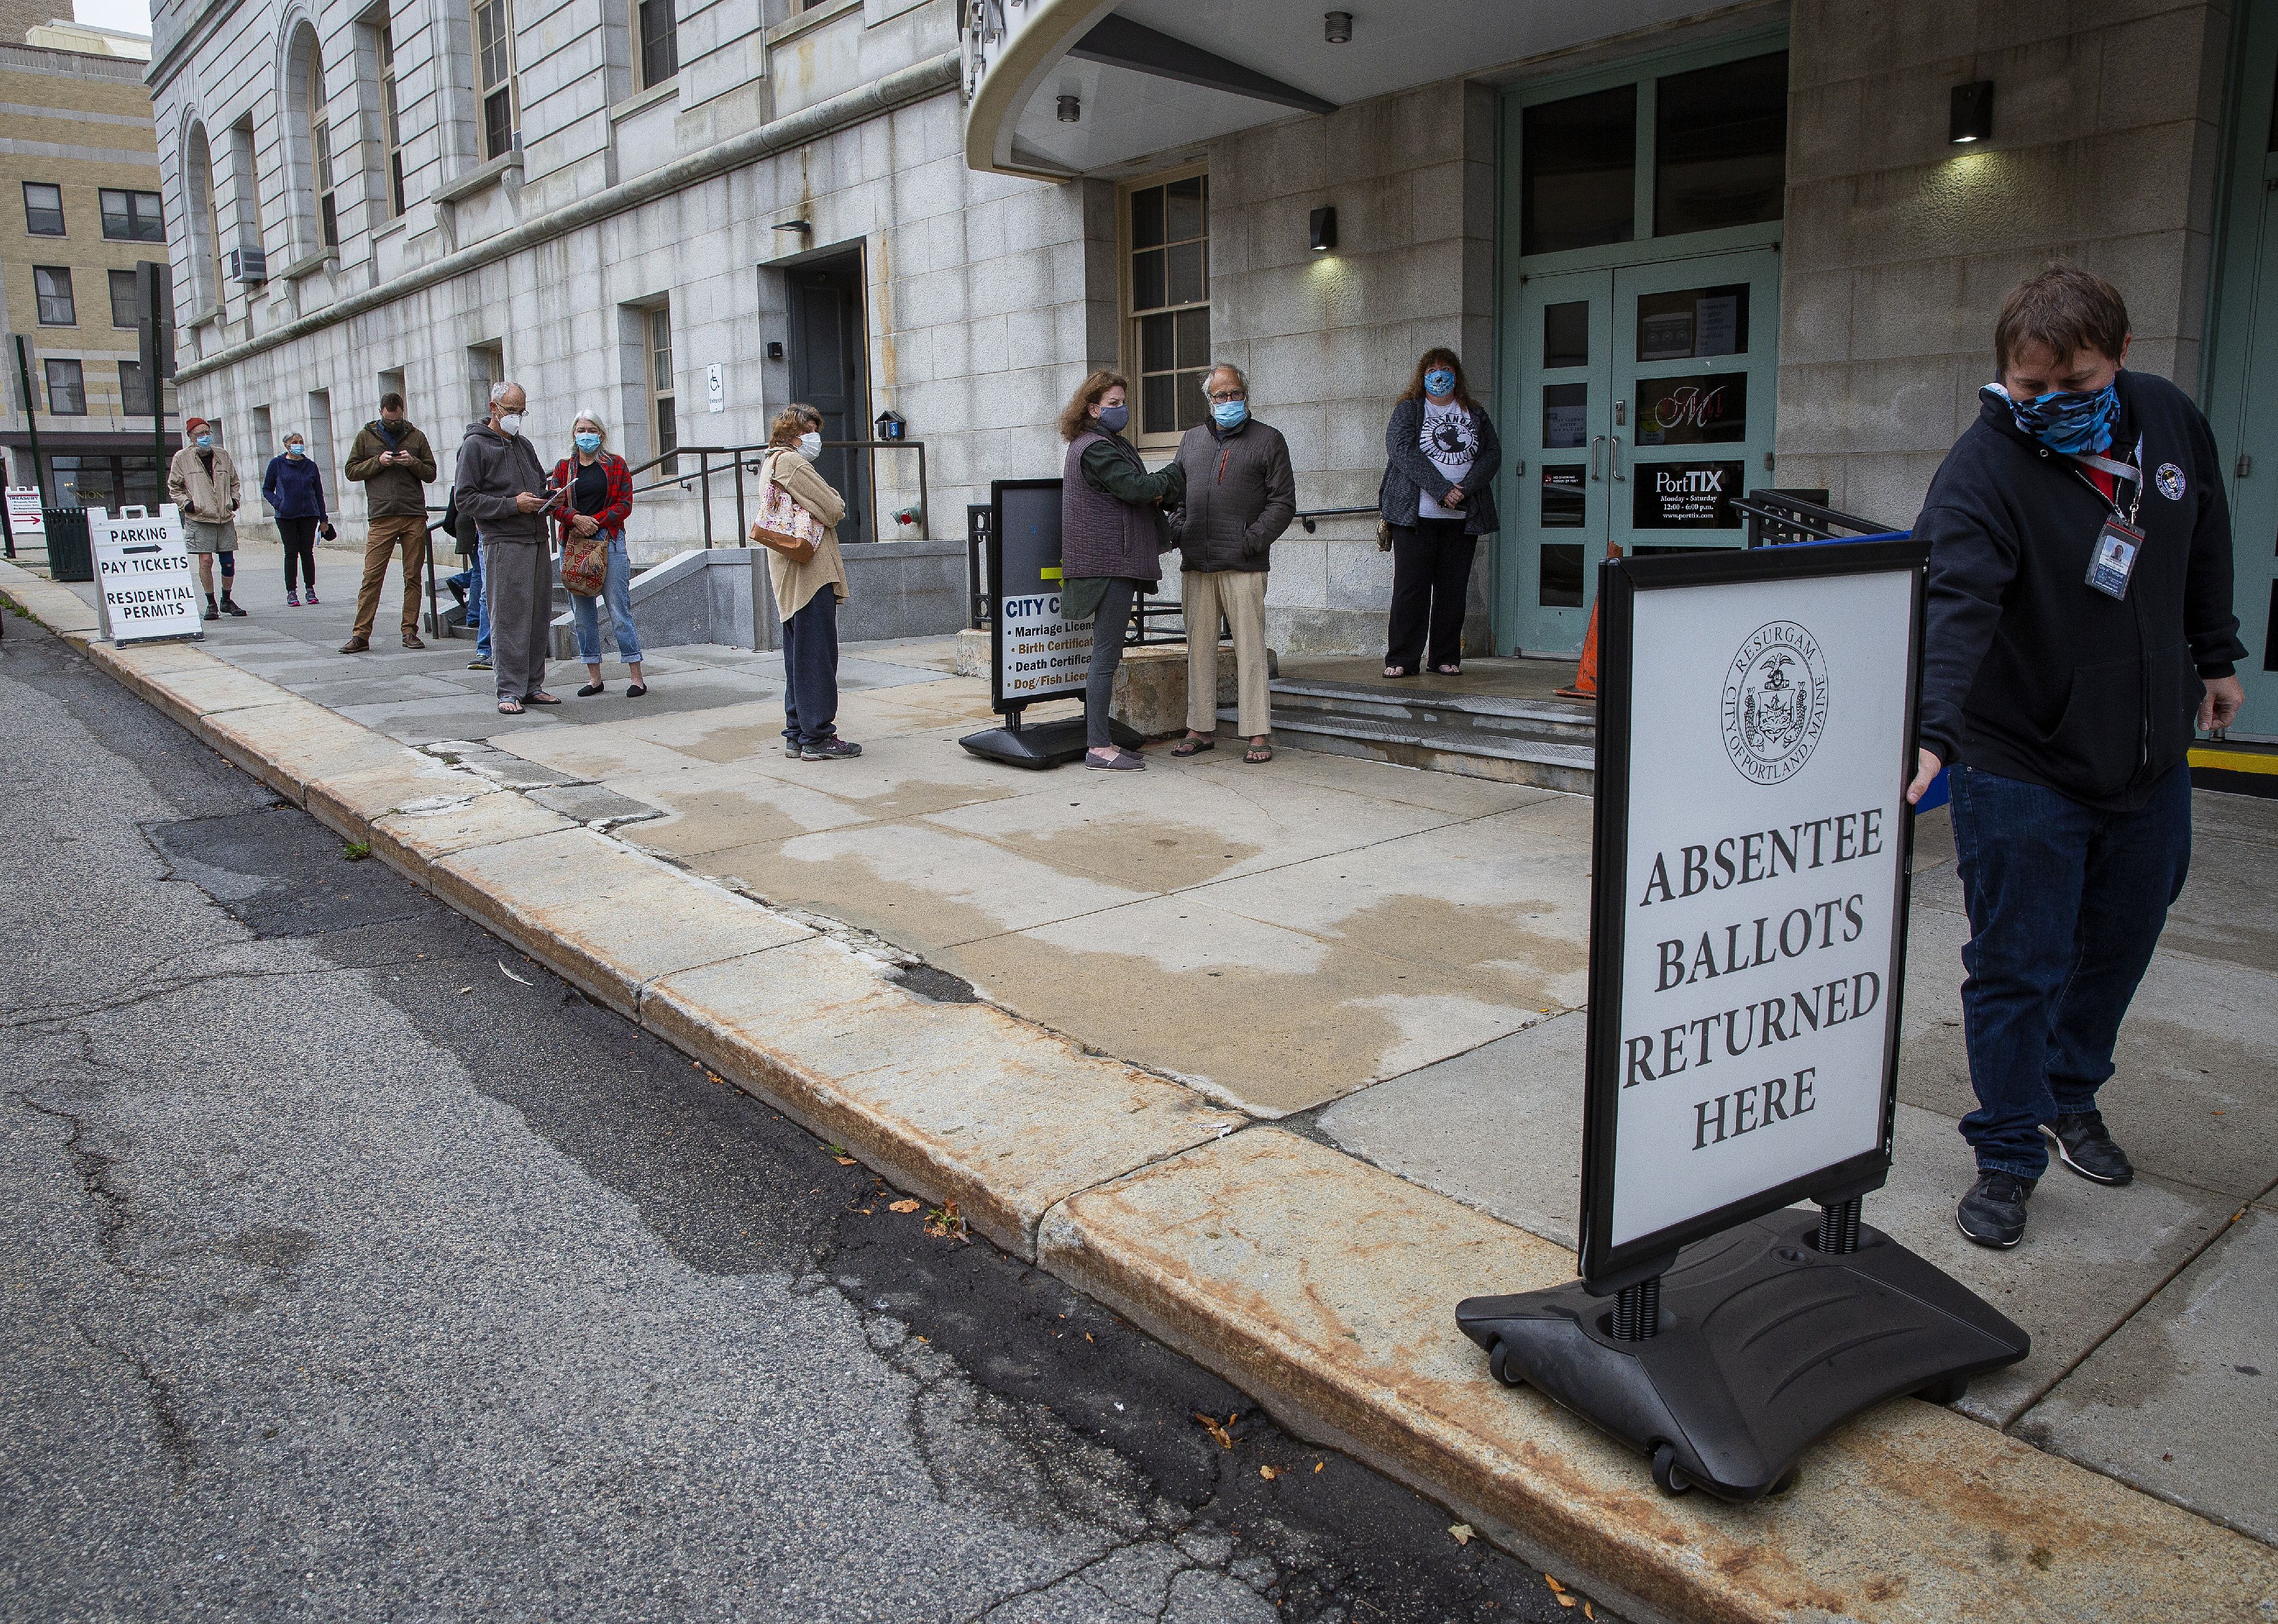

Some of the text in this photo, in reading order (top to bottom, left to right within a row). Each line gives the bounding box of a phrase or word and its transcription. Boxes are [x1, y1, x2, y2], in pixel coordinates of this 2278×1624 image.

[1656, 470, 1723, 492] PortTIX
[1690, 495, 1717, 503] Saturday
[111, 528, 167, 542] PARKING
[101, 556, 189, 574] PAY TICKETS
[107, 587, 194, 605] RESIDENTIAL
[124, 603, 185, 619] PERMITS
[1005, 597, 1062, 618] CITY C
[1015, 623, 1062, 637] Marriage
[1018, 636, 1094, 655] Birth Certificat
[1016, 659, 1047, 672] Death
[1014, 674, 1062, 690] Dog/Fish
[1725, 686, 1737, 733] CITY
[1808, 674, 1825, 740] MAINE
[1730, 735, 1745, 758] OF
[1639, 807, 1883, 907] ABSENTEE
[1654, 893, 1864, 993] BALLOTS
[1623, 971, 1880, 1089] RETURNED
[1692, 1066, 1816, 1151] HERE
